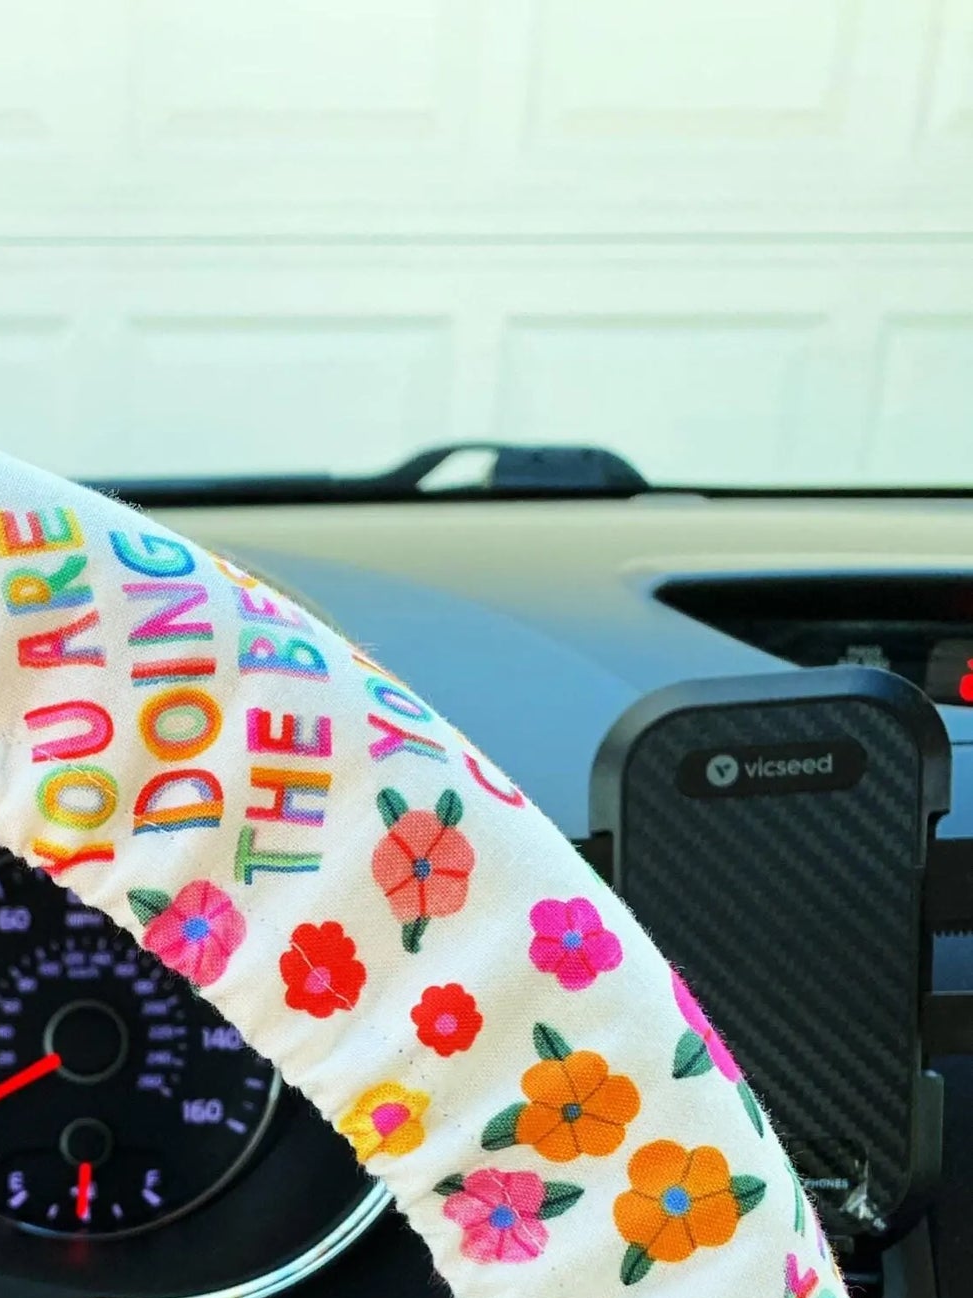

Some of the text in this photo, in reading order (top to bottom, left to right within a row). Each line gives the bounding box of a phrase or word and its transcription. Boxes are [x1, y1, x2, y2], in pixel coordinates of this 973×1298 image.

[109, 529, 225, 836] DOING
[744, 753, 834, 779] vicseed
[23, 699, 118, 877] YOU
[234, 707, 332, 886] THE
[182, 1099, 224, 1125] 160
